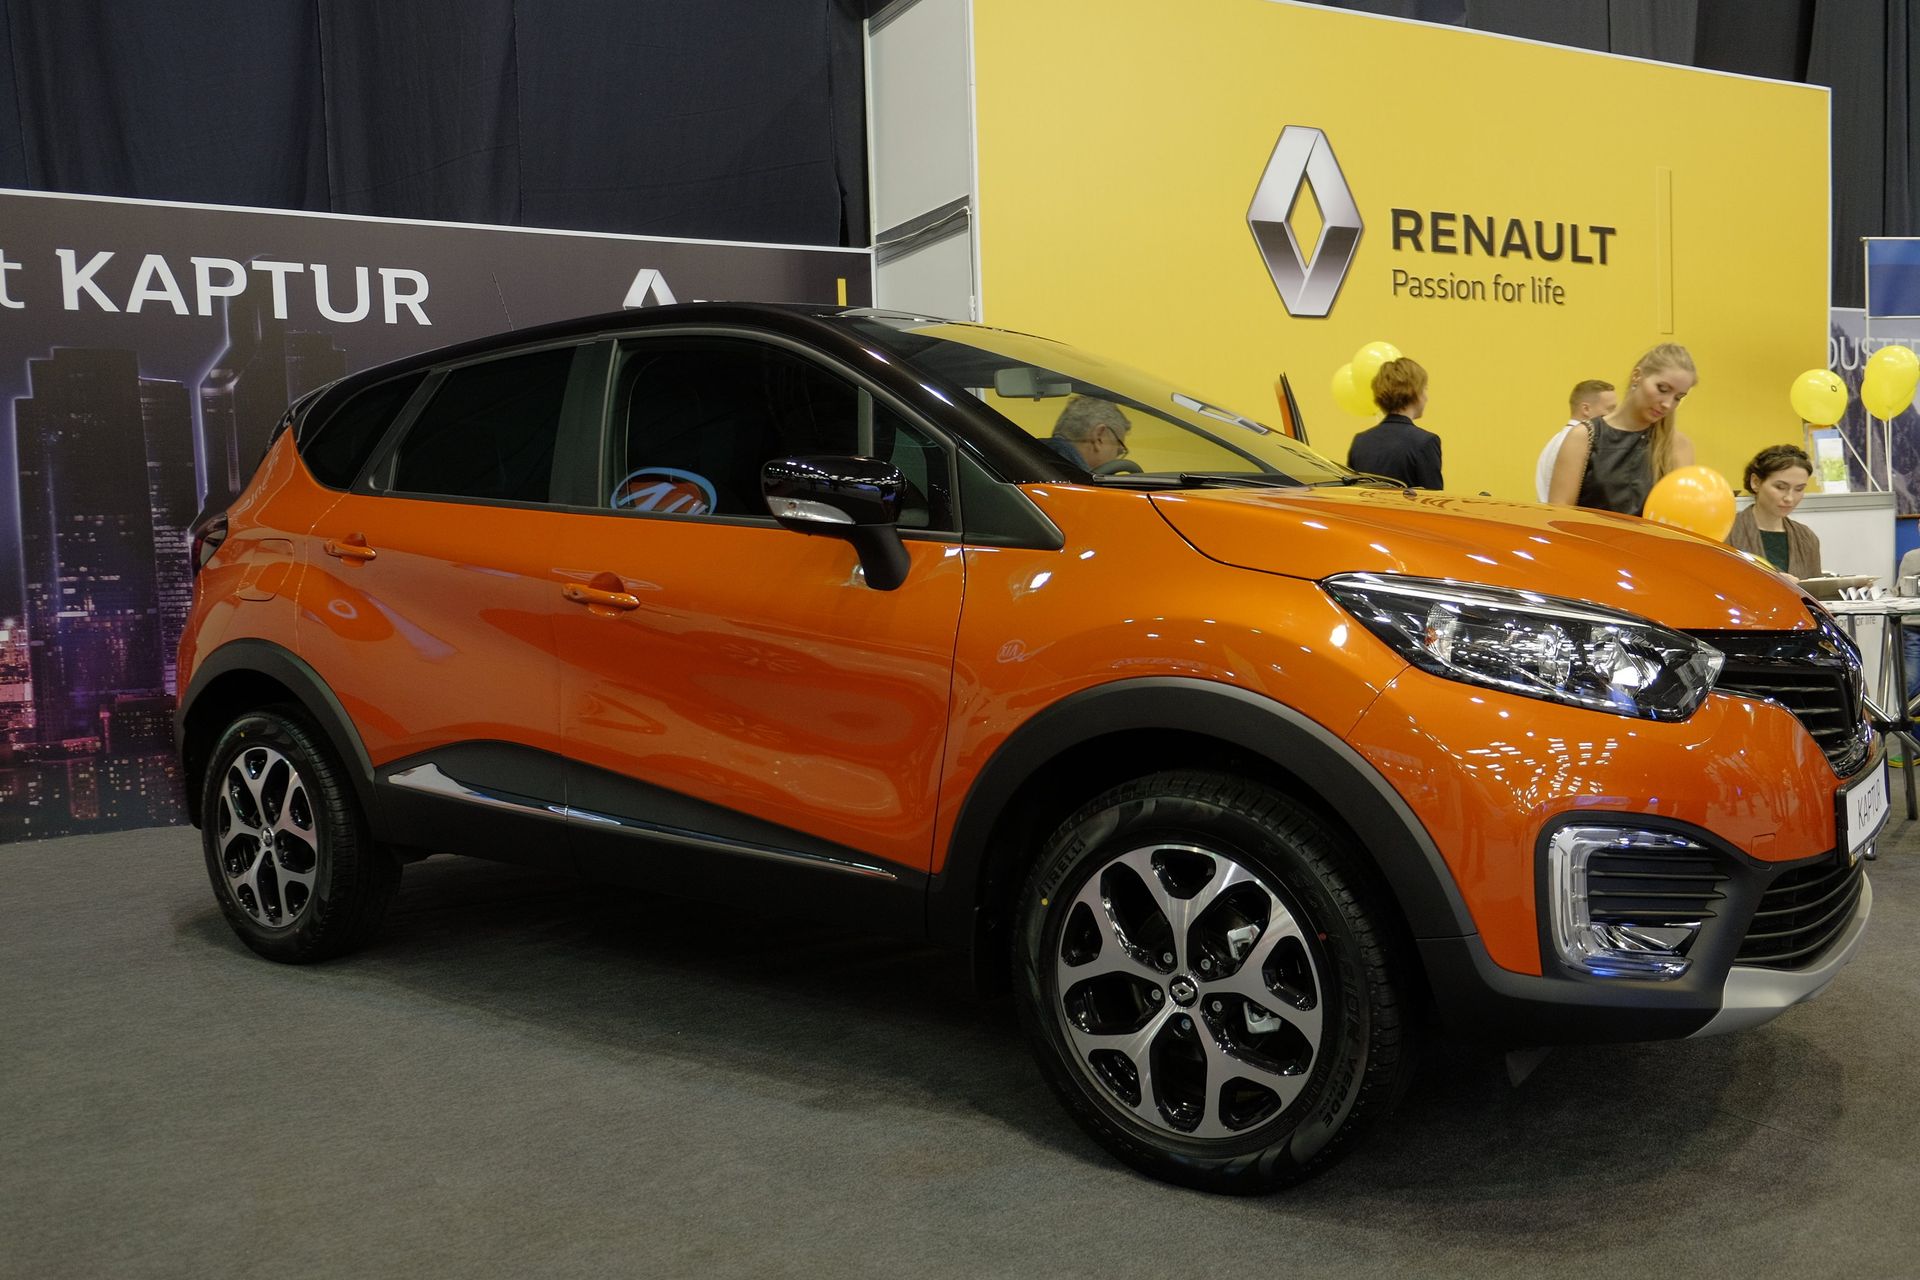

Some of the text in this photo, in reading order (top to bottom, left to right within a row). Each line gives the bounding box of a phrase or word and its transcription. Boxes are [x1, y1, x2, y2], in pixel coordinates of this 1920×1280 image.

[1391, 208, 1617, 266] RENAULT
[55, 248, 432, 326] KAPTUR
[1392, 268, 1565, 306] Passion for life
